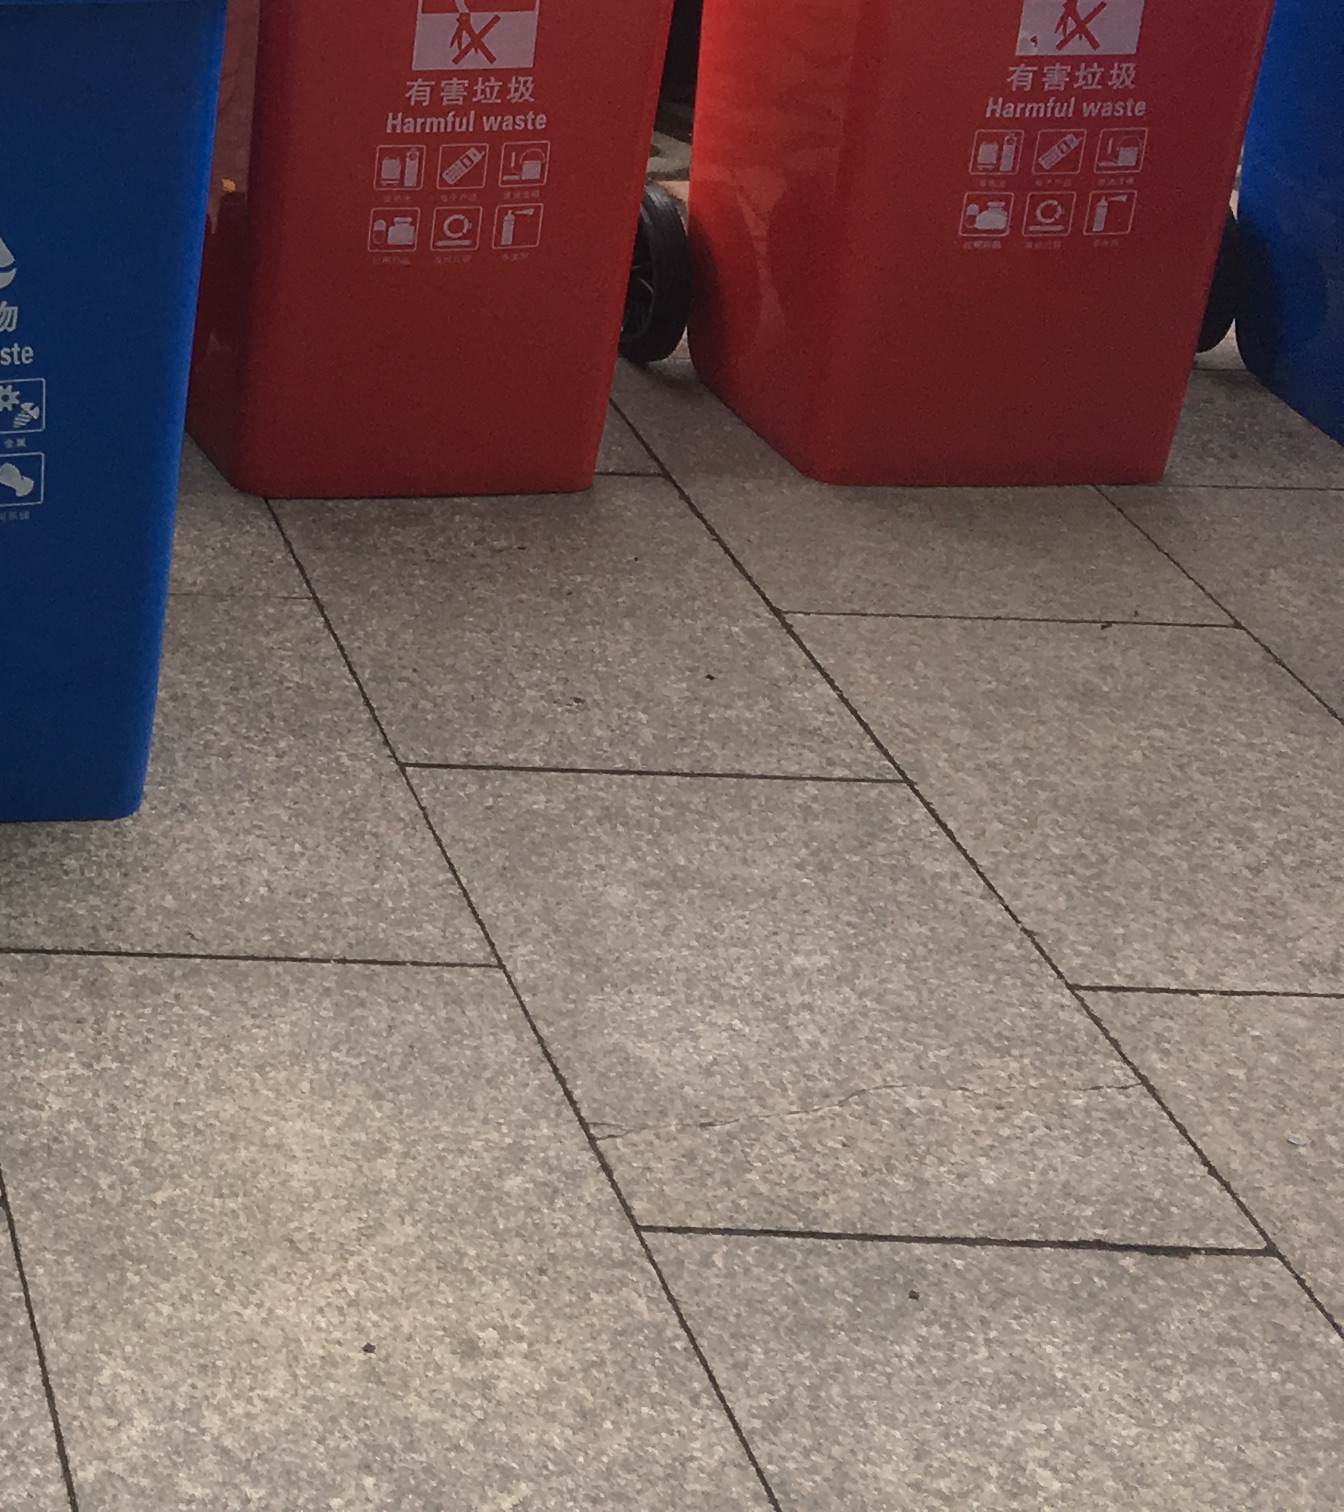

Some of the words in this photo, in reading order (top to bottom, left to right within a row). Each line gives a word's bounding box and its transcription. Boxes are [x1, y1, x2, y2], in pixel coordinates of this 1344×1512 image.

[1007, 62, 1136, 92] 有害垃圾
[405, 76, 535, 106] 有害垃圾
[985, 96, 1075, 118] Harmful
[1082, 98, 1147, 117] waste
[386, 110, 475, 133] Harmful
[482, 111, 547, 132] waste
